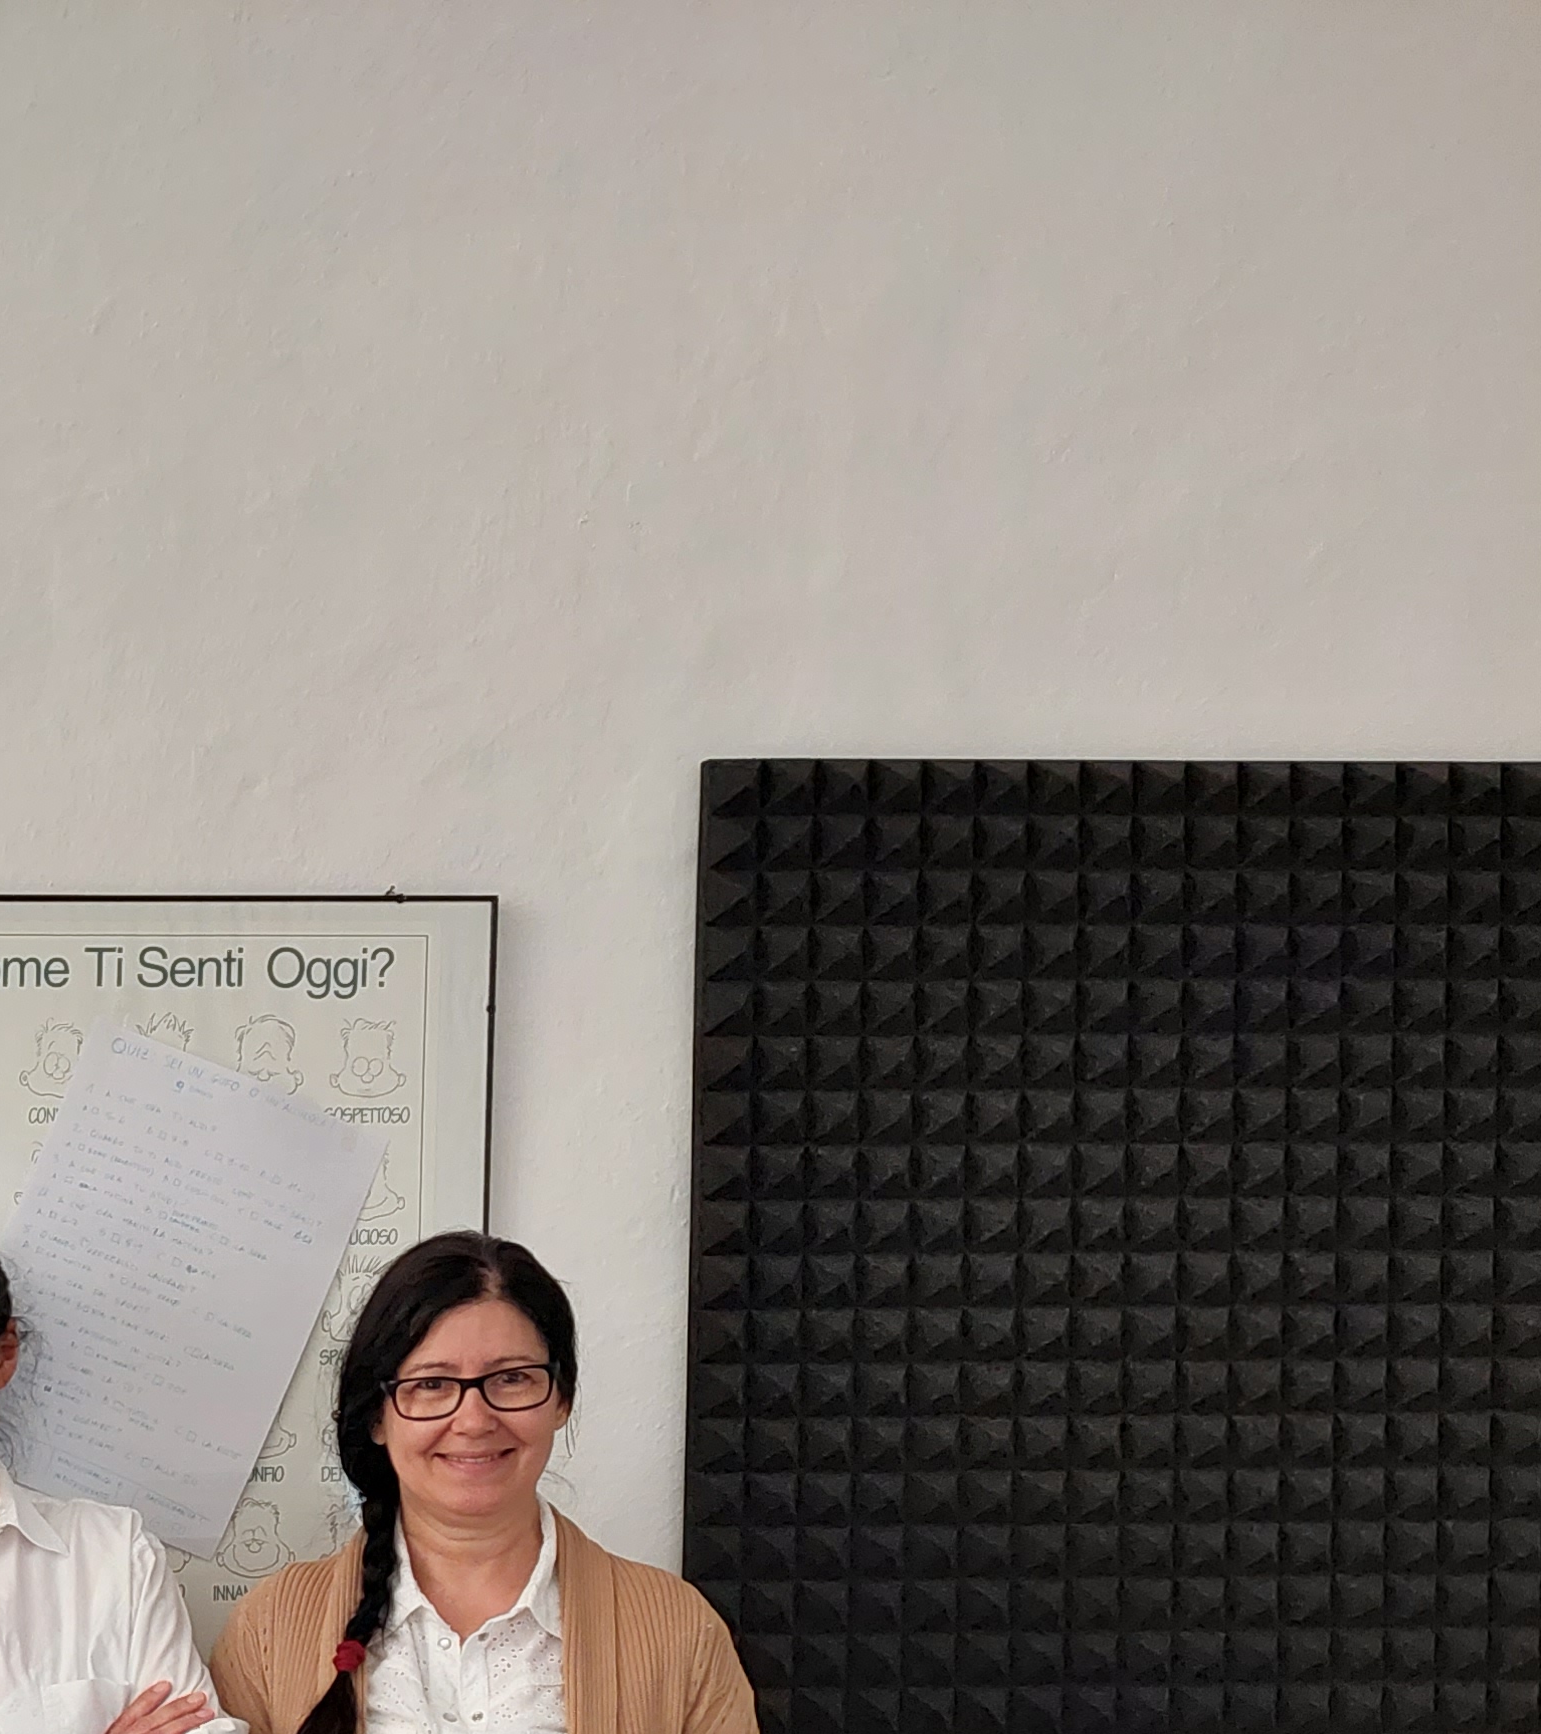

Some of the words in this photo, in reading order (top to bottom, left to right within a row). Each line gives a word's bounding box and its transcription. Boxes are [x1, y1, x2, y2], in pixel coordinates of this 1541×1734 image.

[84, 946, 123, 988] Ti
[137, 946, 243, 988] Senti
[267, 946, 395, 1000] Oggi?
[28, 1106, 58, 1124] CON
[213, 1584, 249, 1601] INNA
